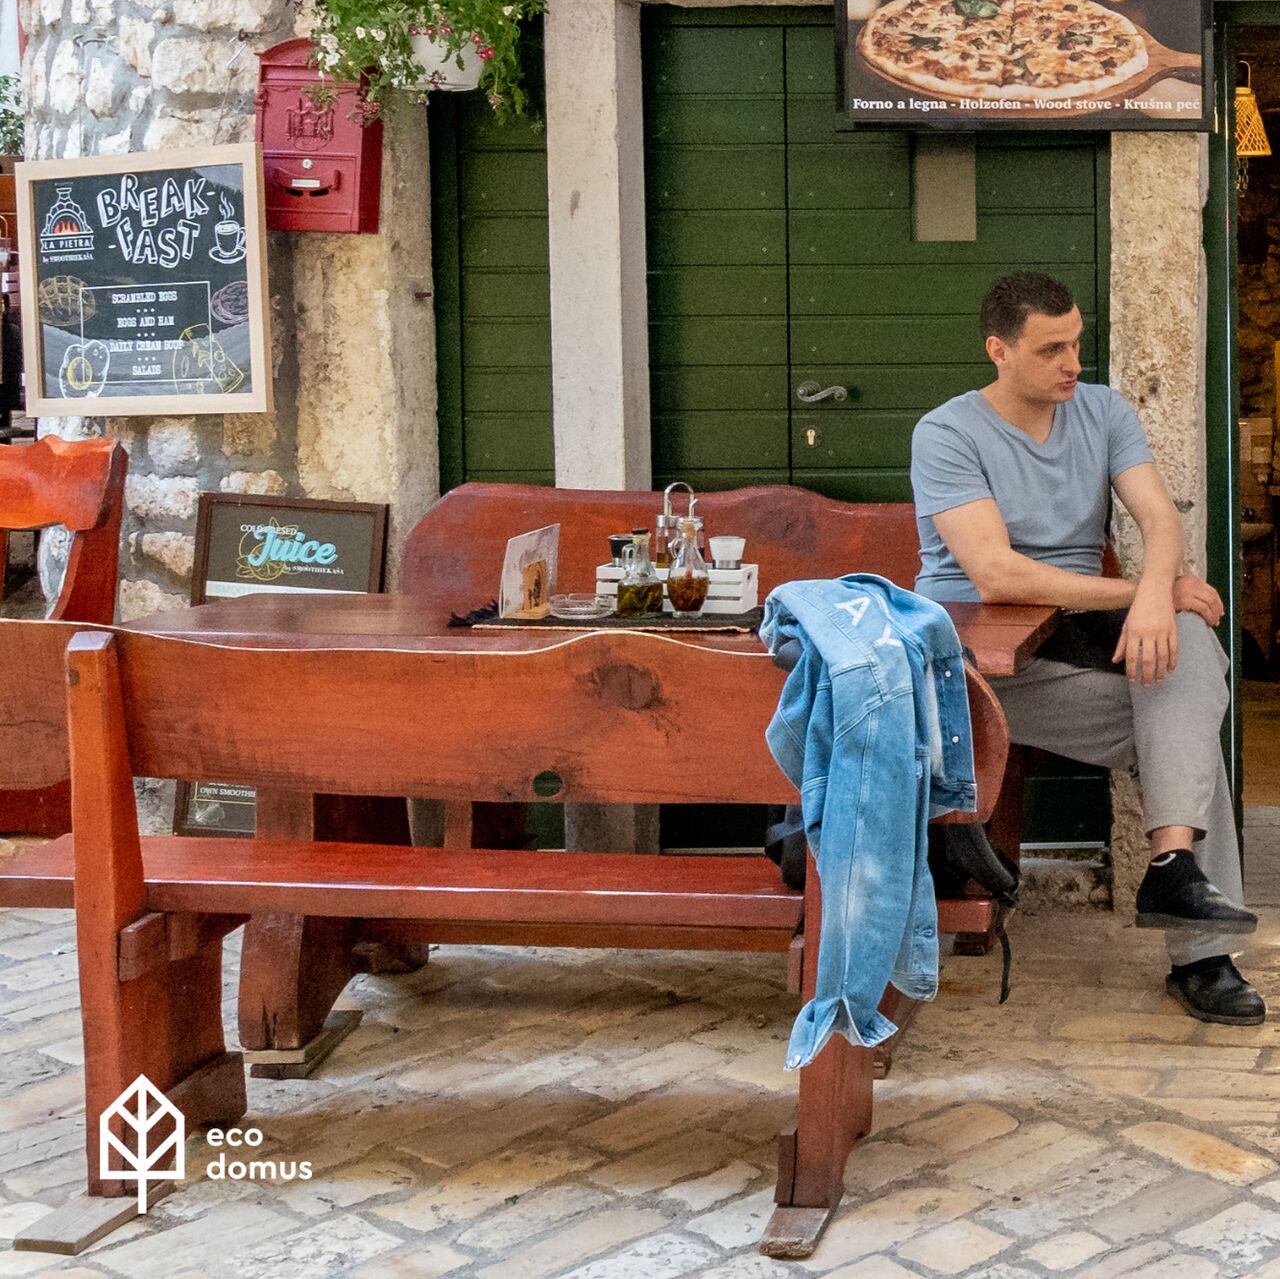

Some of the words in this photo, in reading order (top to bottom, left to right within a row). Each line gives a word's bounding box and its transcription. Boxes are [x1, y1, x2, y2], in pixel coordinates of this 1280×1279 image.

[852, 98, 894, 110] Forno
[896, 100, 906, 110] a
[909, 98, 948, 112] legna
[959, 98, 1022, 110] Holzofen
[1033, 98, 1073, 110] Wood
[1075, 100, 1112, 110] stove
[1123, 98, 1171, 110] Krušna
[44, 241, 55, 250] LA
[59, 239, 91, 249] PIETRA
[112, 291, 157, 304] SCRAMBLED
[158, 290, 178, 301] EGGS
[117, 317, 137, 328] EGGS
[139, 316, 155, 327] AND
[158, 315, 175, 326] HAM
[110, 341, 134, 352] DAILY
[132, 364, 161, 376] SALADS
[247, 526, 338, 567] Juice
[200, 787, 217, 796] OWN
